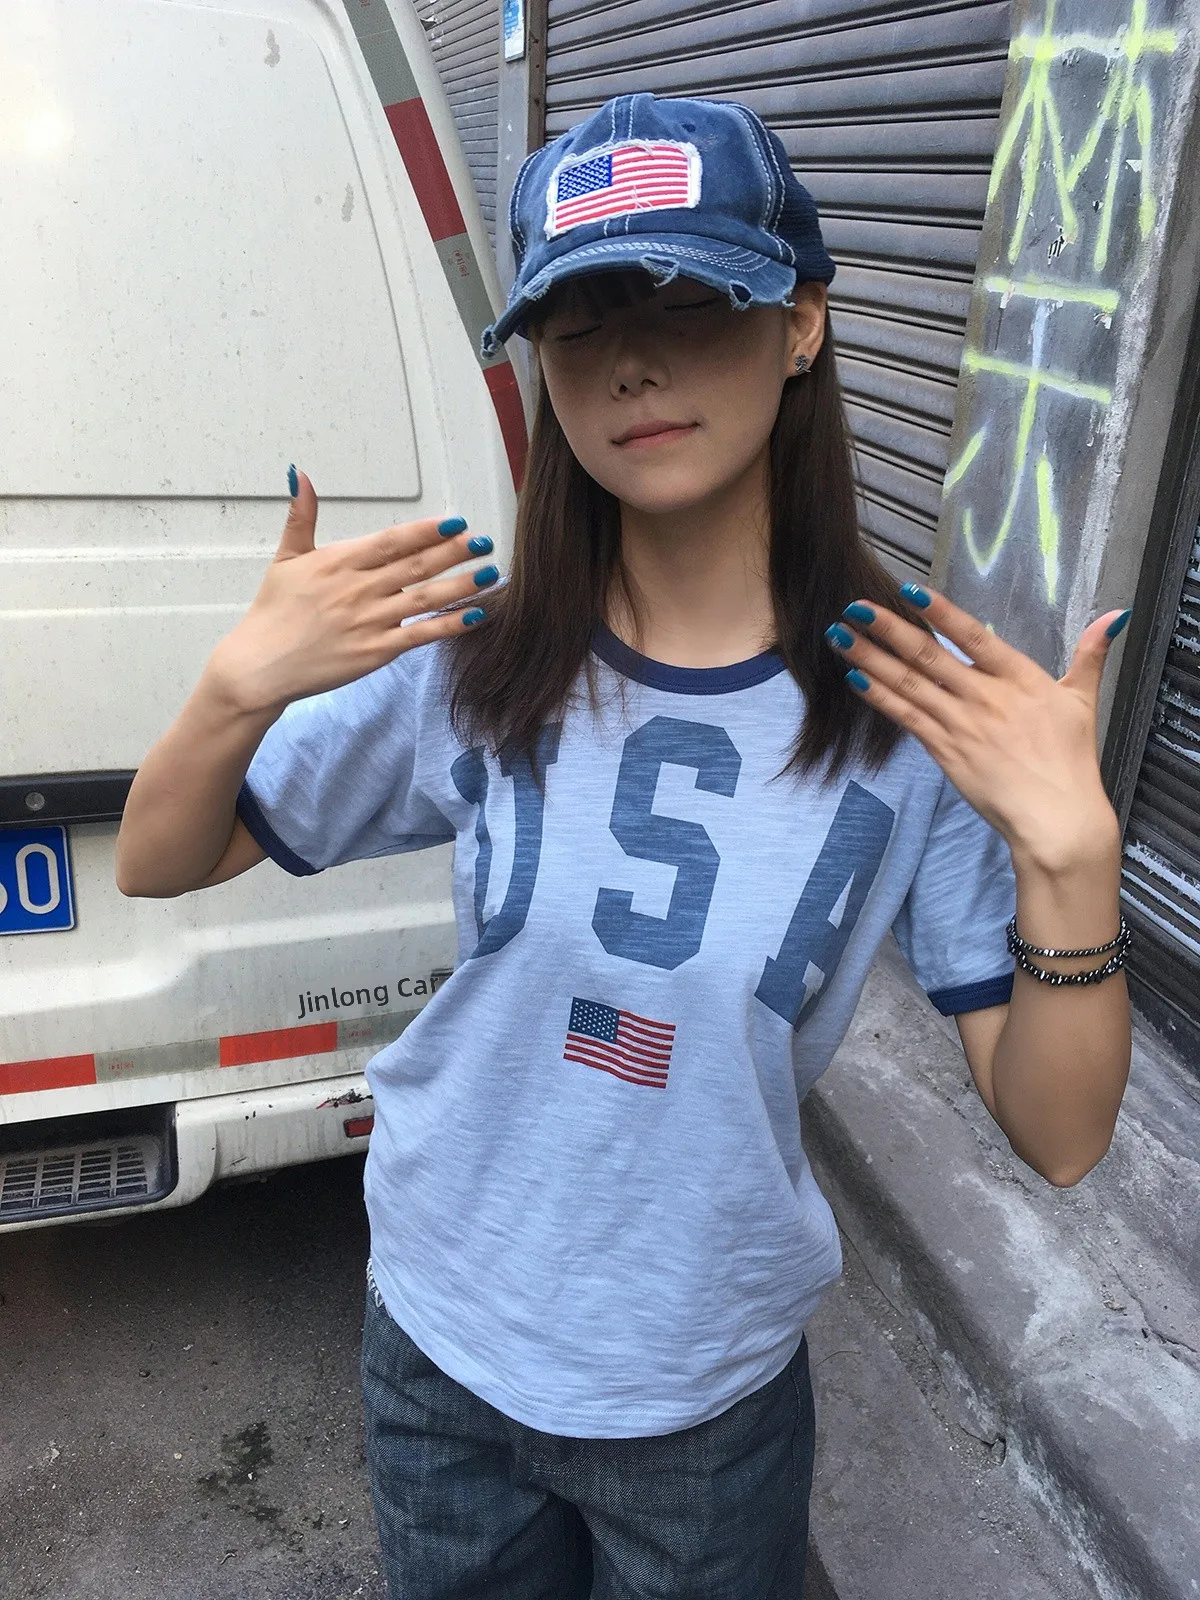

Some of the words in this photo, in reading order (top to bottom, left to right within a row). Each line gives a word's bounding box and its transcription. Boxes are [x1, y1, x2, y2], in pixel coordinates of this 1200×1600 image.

[0, 843, 60, 914] 0
[450, 715, 895, 1032] USA
[298, 985, 389, 1019] Jinlong
